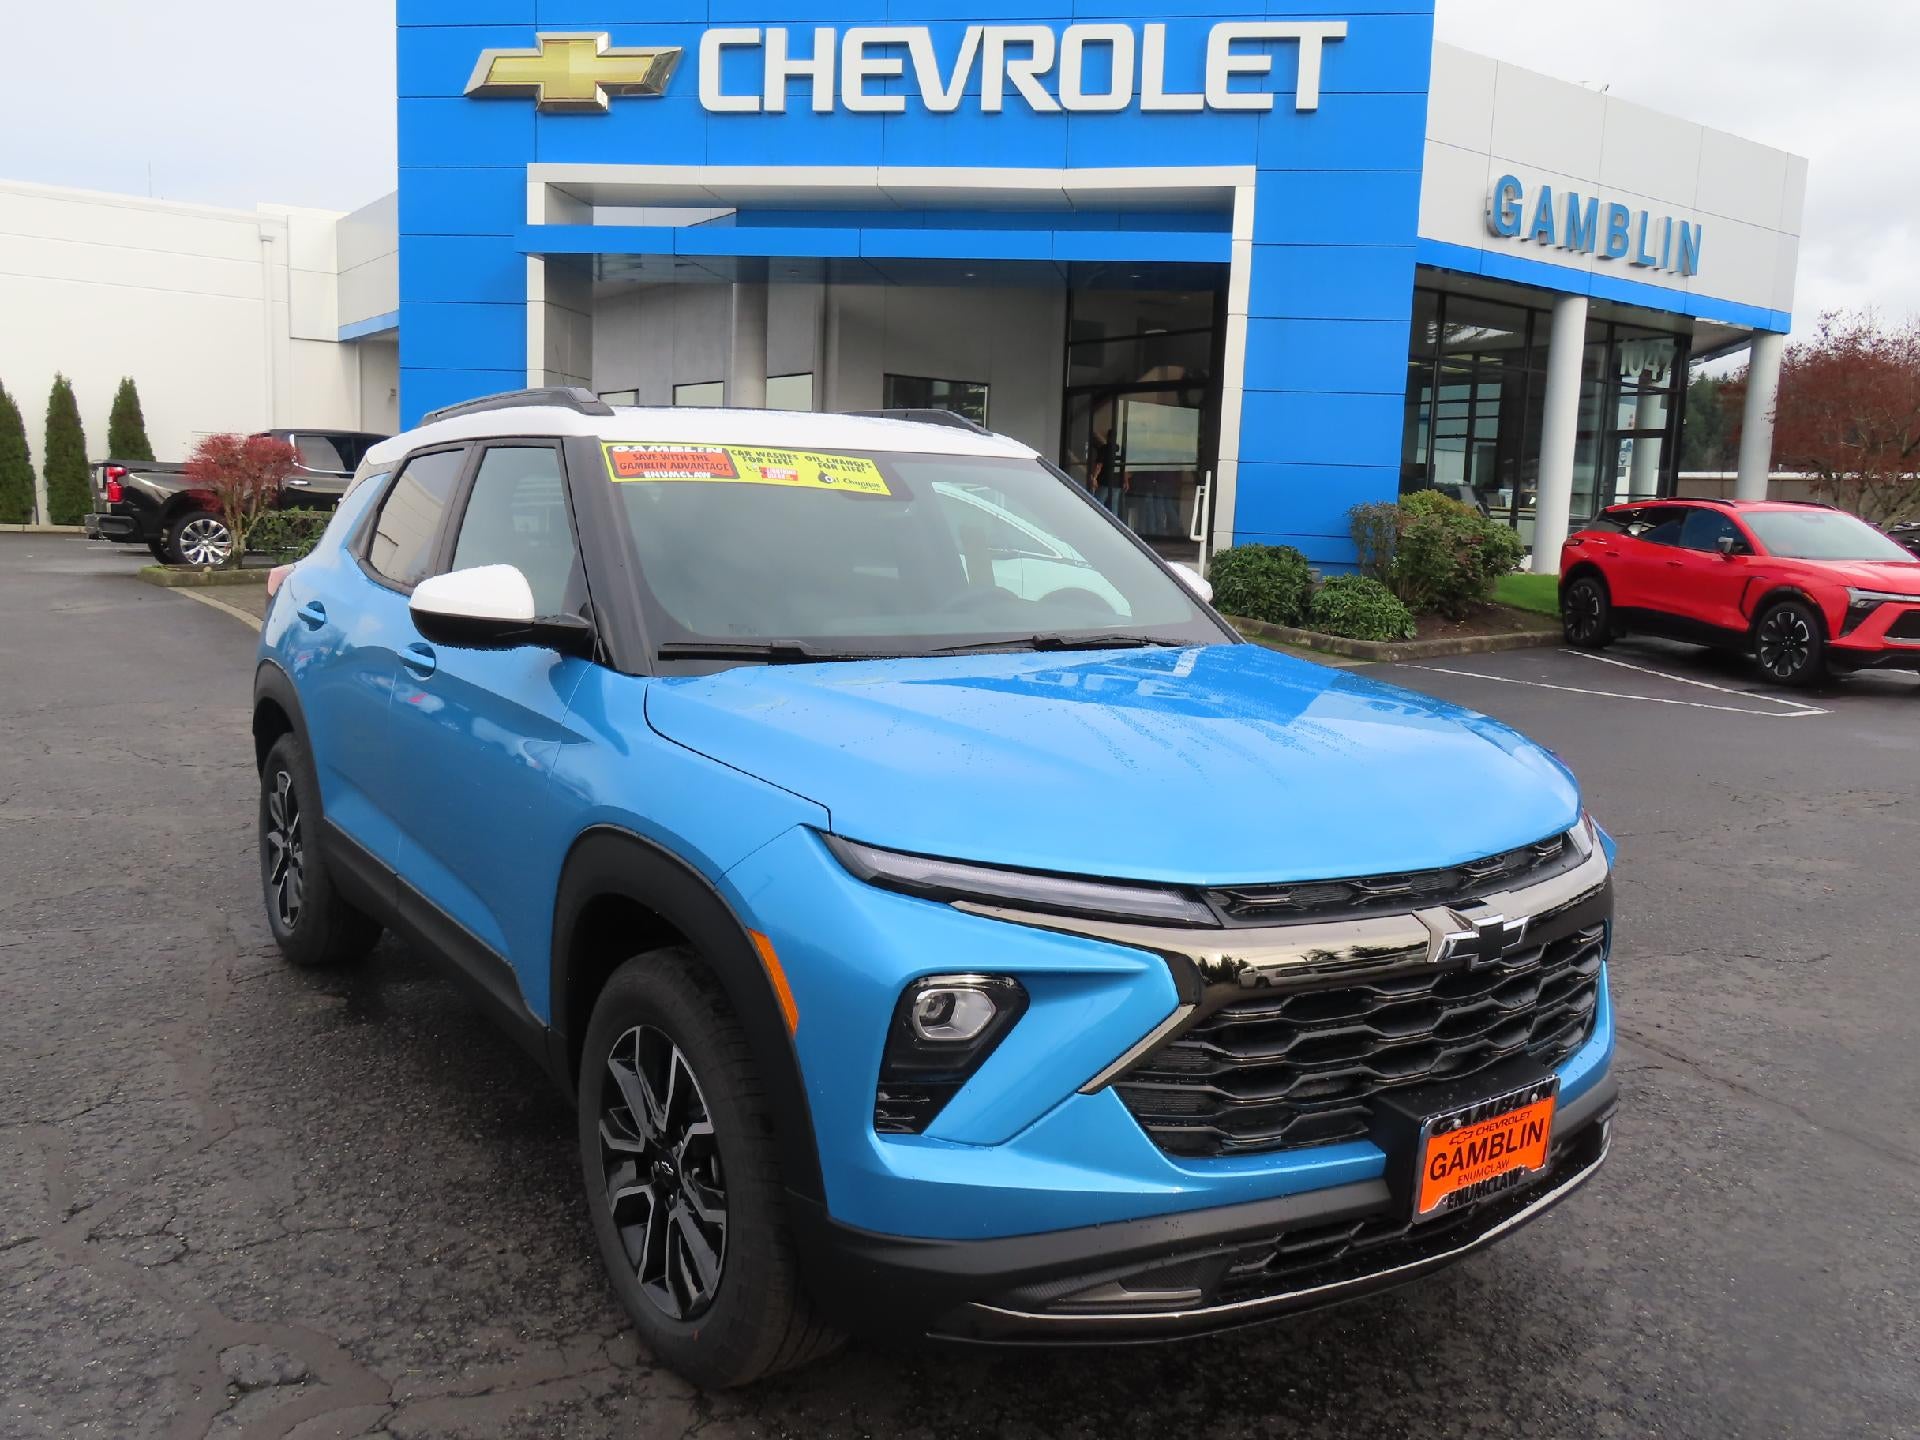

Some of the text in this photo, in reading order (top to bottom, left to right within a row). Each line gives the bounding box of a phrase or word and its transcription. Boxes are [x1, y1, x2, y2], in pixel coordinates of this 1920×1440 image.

[699, 20, 1348, 114] CHEVROLET
[1488, 173, 1702, 277] GAMBLIN
[620, 462, 729, 471] GAMBLIN ADVANTAGE
[633, 453, 658, 461] SAVE
[731, 449, 799, 460] CAR WASHES
[1475, 1111, 1533, 1136] CHEVROLET
[1430, 1118, 1545, 1181] GAMBLIN
[1457, 1159, 1510, 1186] ENUMCLAW
[1446, 1167, 1521, 1210] ENUMCLAW
